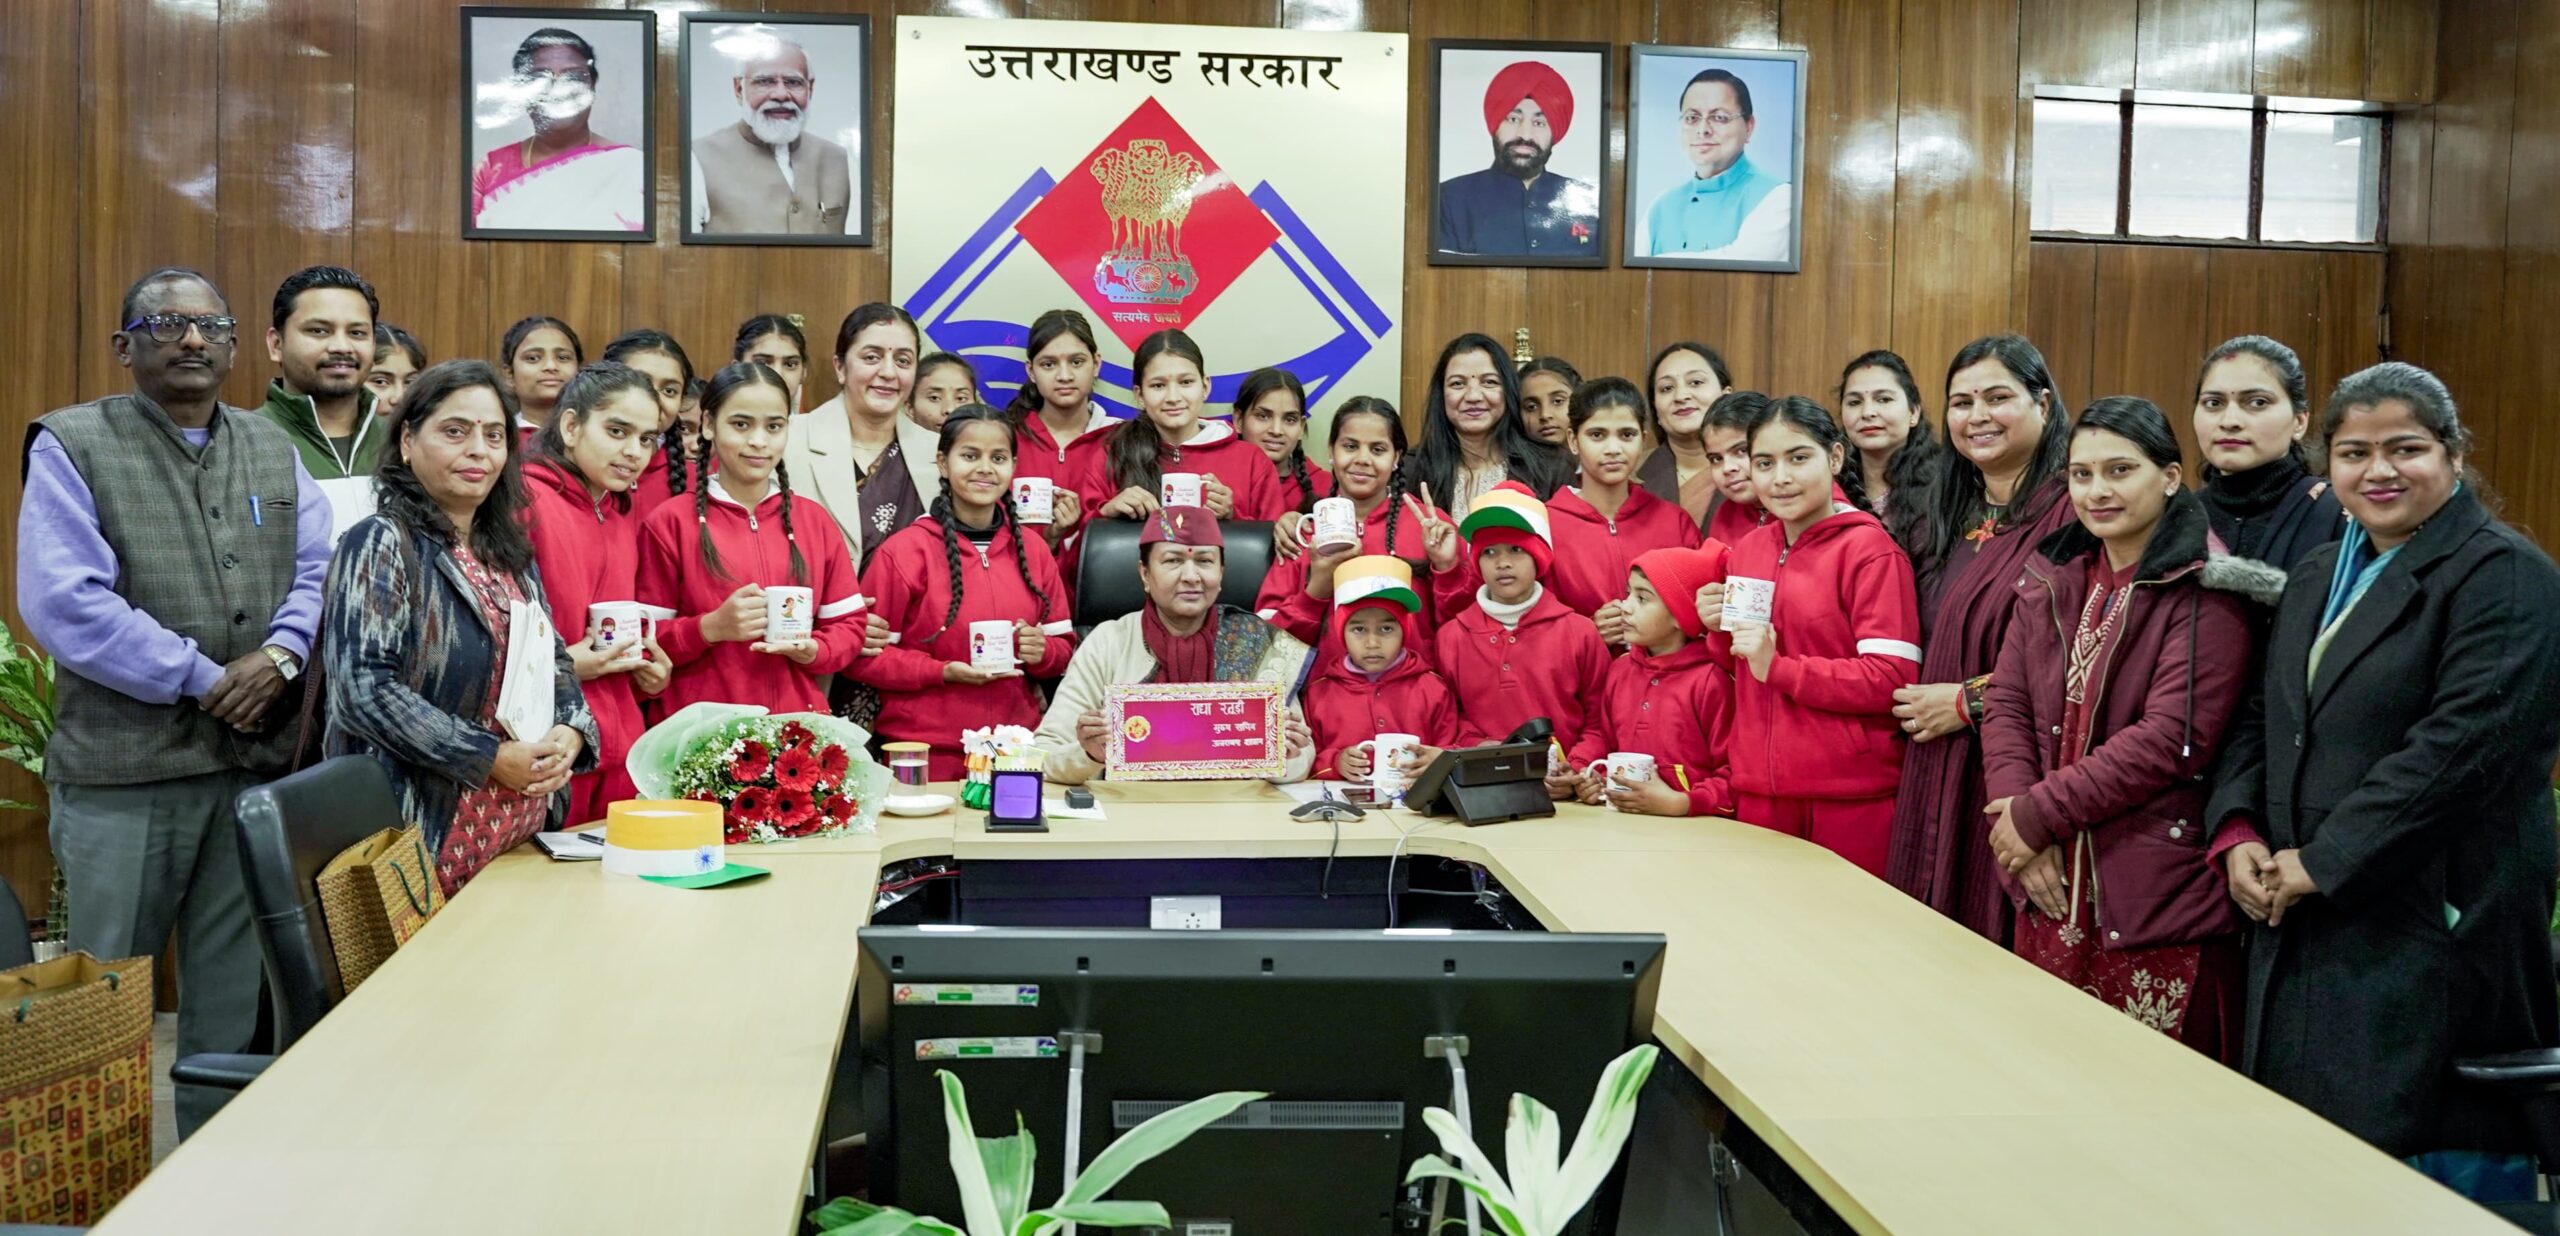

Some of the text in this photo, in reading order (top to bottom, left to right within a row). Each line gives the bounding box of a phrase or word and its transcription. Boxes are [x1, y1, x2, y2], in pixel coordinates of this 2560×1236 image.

[965, 45, 1343, 90] उत्तराखण्ड सरकार
[1112, 309, 1181, 323] सत्यमेव जयते
